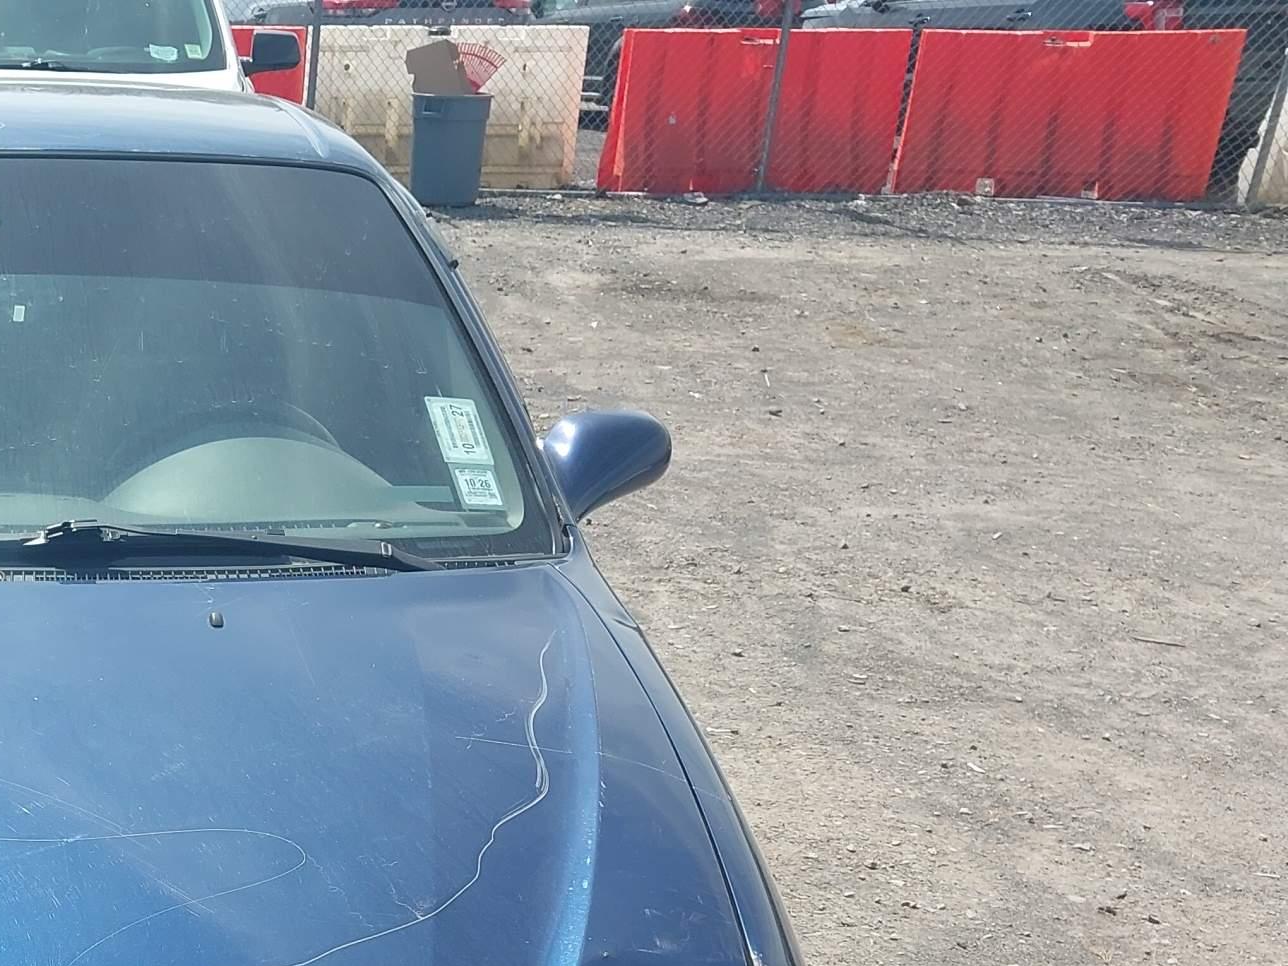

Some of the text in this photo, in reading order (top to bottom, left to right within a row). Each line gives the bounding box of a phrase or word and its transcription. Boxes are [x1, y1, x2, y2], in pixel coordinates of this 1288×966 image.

[384, 17, 505, 25] PATHFINDER
[449, 404, 464, 417] 27
[462, 443, 476, 455] 10
[464, 478, 491, 489] 10 26
